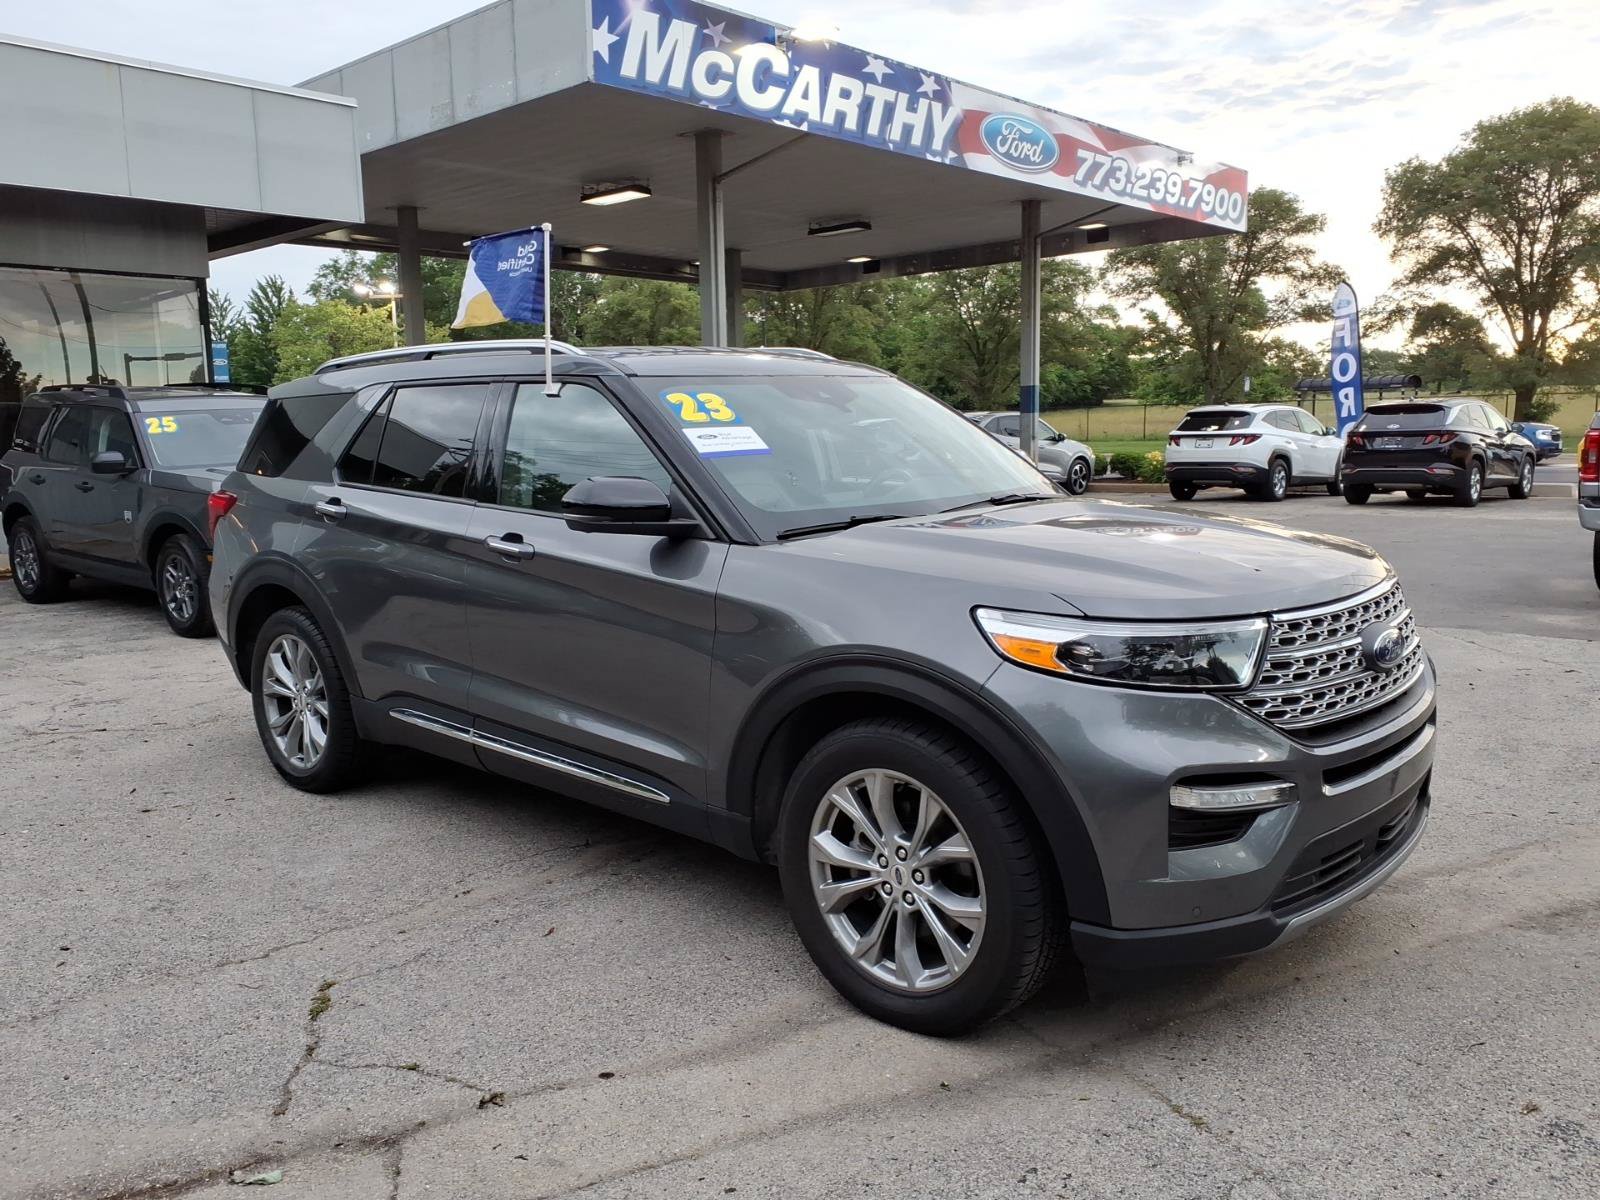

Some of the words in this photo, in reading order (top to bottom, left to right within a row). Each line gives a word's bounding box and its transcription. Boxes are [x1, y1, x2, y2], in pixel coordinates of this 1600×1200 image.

[619, 9, 963, 151] McCARTHY
[996, 120, 1045, 164] Ford
[1075, 149, 1243, 220] 773.239.7900
[144, 416, 177, 434] 25
[665, 392, 736, 422] 23
